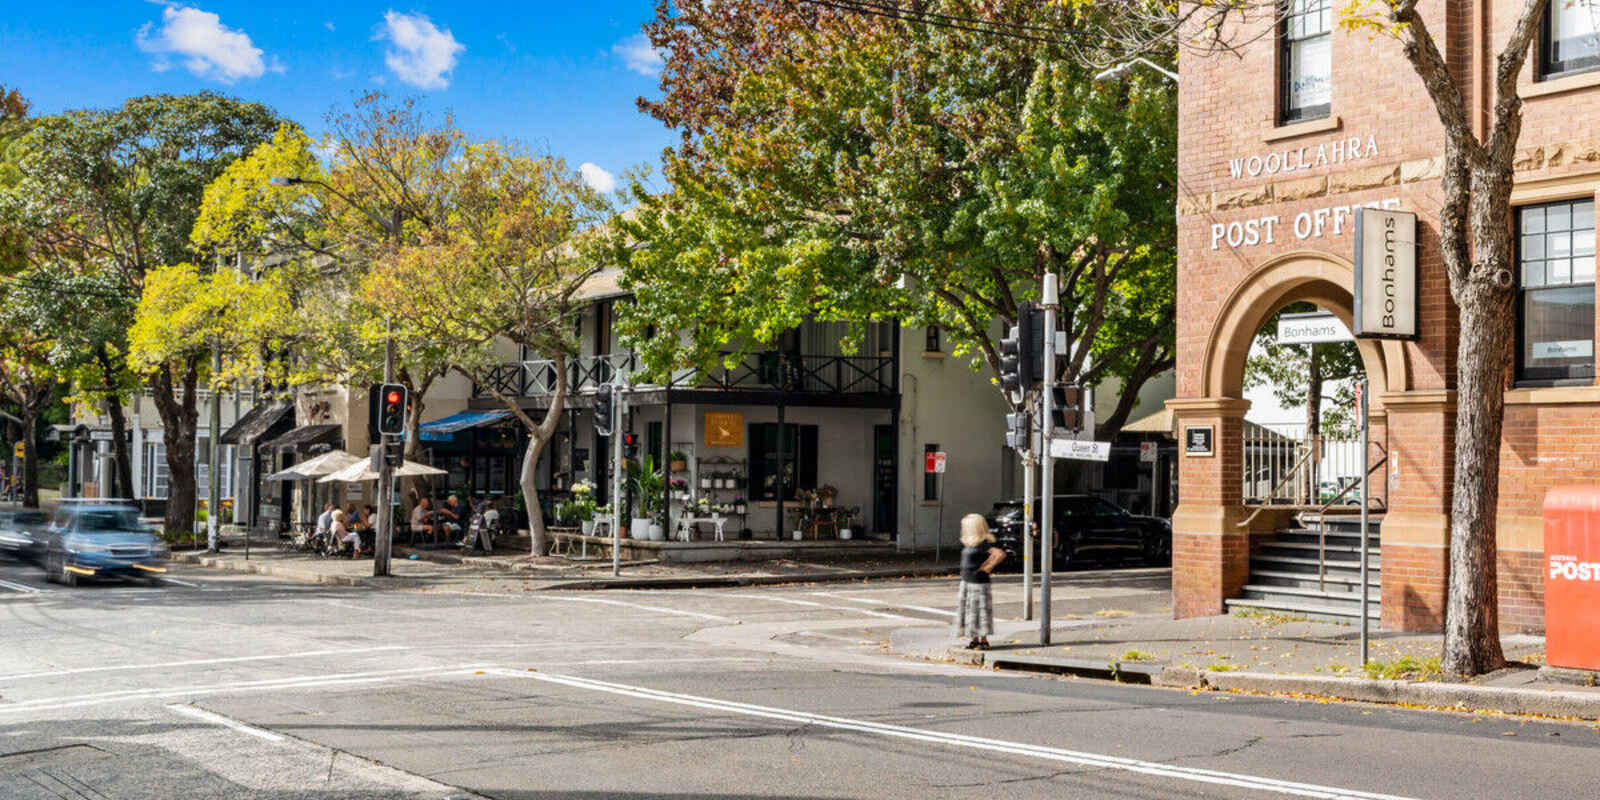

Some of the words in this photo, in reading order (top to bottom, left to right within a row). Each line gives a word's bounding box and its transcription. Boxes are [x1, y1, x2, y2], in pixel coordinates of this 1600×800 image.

[1229, 135, 1379, 179] WOOLLAHRA
[1210, 216, 1280, 250] POST
[1294, 198, 1401, 240] OFF
[1381, 216, 1396, 329] Bonhams
[1284, 325, 1337, 338] Bonhams
[1549, 561, 1600, 581] POST
